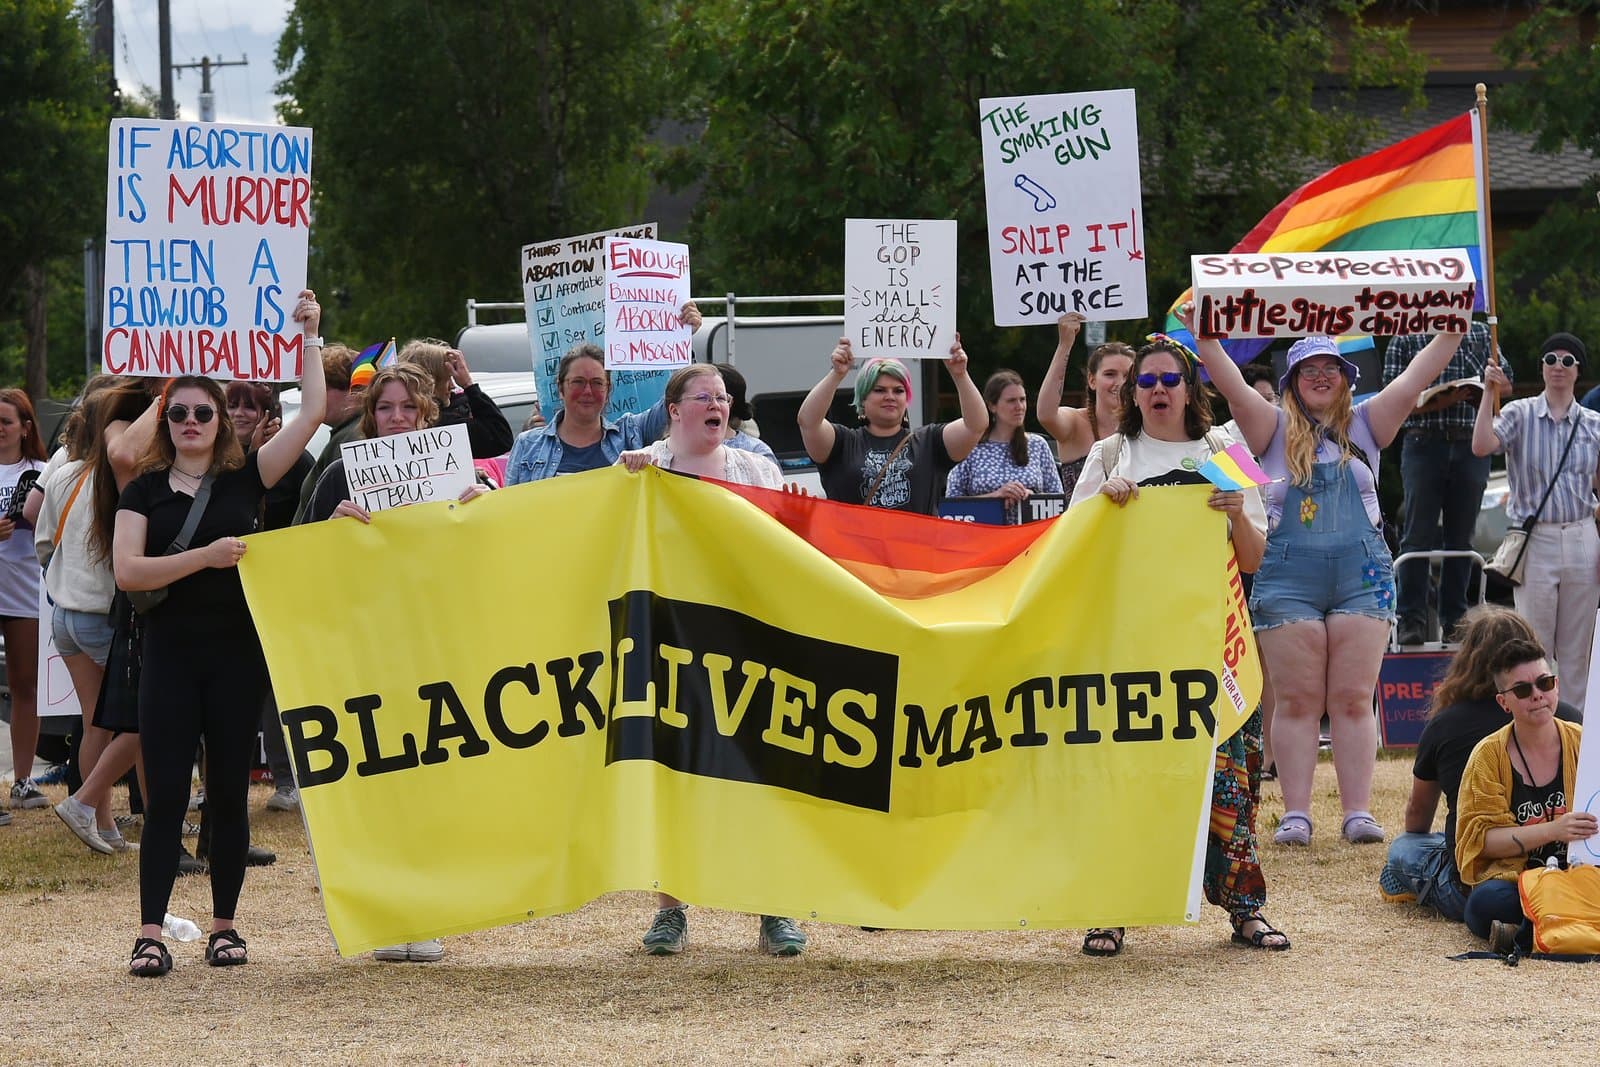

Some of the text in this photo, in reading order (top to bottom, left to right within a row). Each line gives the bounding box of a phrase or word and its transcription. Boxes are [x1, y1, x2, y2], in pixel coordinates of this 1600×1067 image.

[981, 102, 1030, 136] THE
[1000, 104, 1102, 164] SMOKING
[1055, 127, 1111, 165] GUN
[119, 127, 308, 174] IF ABORTION
[118, 173, 309, 228] IS MURDER
[875, 223, 919, 244] THE
[1001, 224, 1070, 255] SNIP
[110, 239, 279, 284] THEN A
[524, 243, 561, 260] THINGS
[568, 236, 605, 254] THAT
[610, 242, 688, 275] ENOUGH
[877, 246, 920, 266] GOP
[526, 257, 594, 284] ABORTION
[888, 268, 908, 287] IS
[1015, 258, 1103, 286] AT THE
[556, 277, 603, 297] Affordable
[610, 283, 677, 306] BANNING
[861, 289, 929, 307] SMALL
[1019, 284, 1123, 316] SOURCE
[109, 285, 284, 333] BLOWJOB IS
[616, 305, 684, 331] ABORTION
[868, 307, 929, 325] dick
[564, 329, 585, 343] Sex
[862, 325, 936, 349] ENERGY
[104, 328, 303, 379] CANNIBALISM
[610, 339, 690, 362] IS MISOGYNY
[616, 370, 664, 386] Assistance
[343, 430, 452, 462] THEY WHO
[348, 452, 459, 490] HATH NOT A
[353, 481, 433, 512] UTERUS
[1030, 499, 1064, 519] THE
[1223, 675, 1236, 694] FOR
[1232, 693, 1243, 710] ALL
[280, 637, 1219, 789] BLACK LIVES MATTER
[1386, 709, 1425, 722] LIVES
